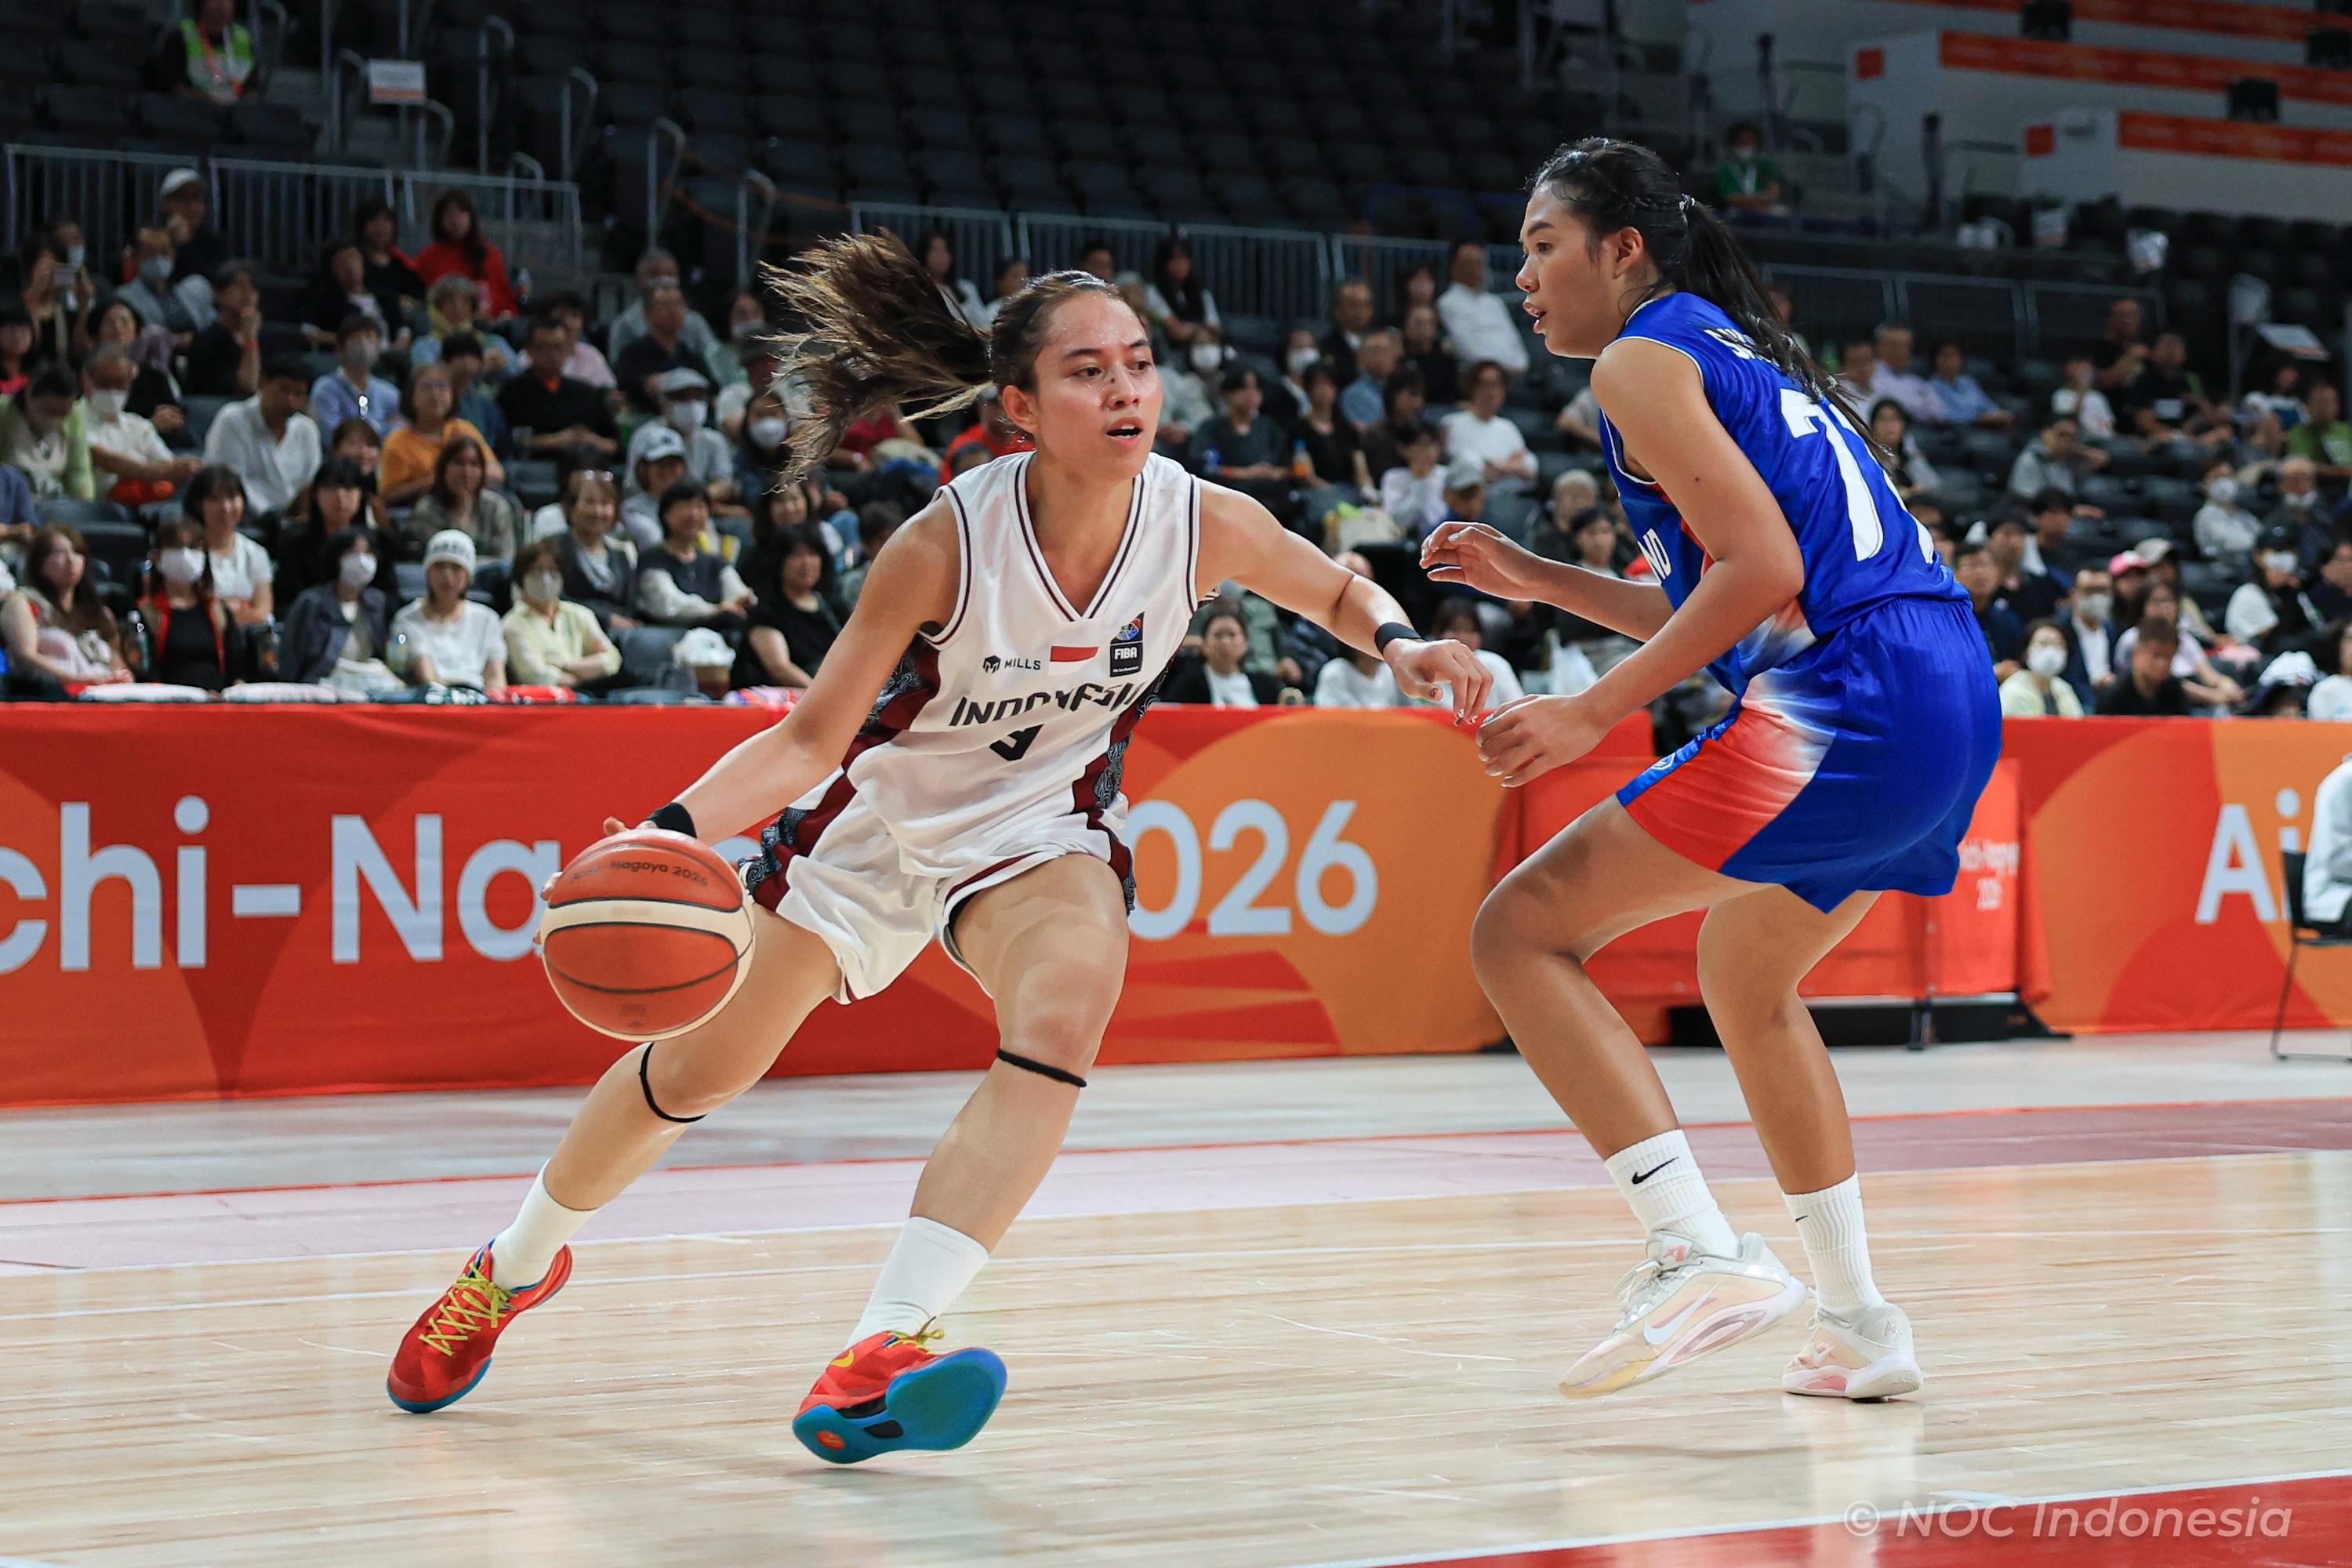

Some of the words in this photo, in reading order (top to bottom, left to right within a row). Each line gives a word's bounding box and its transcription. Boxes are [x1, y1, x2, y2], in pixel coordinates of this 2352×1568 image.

[1114, 647, 1138, 660] FIBA
[1004, 658, 1041, 670] MILLS
[1124, 799, 1378, 941] 026
